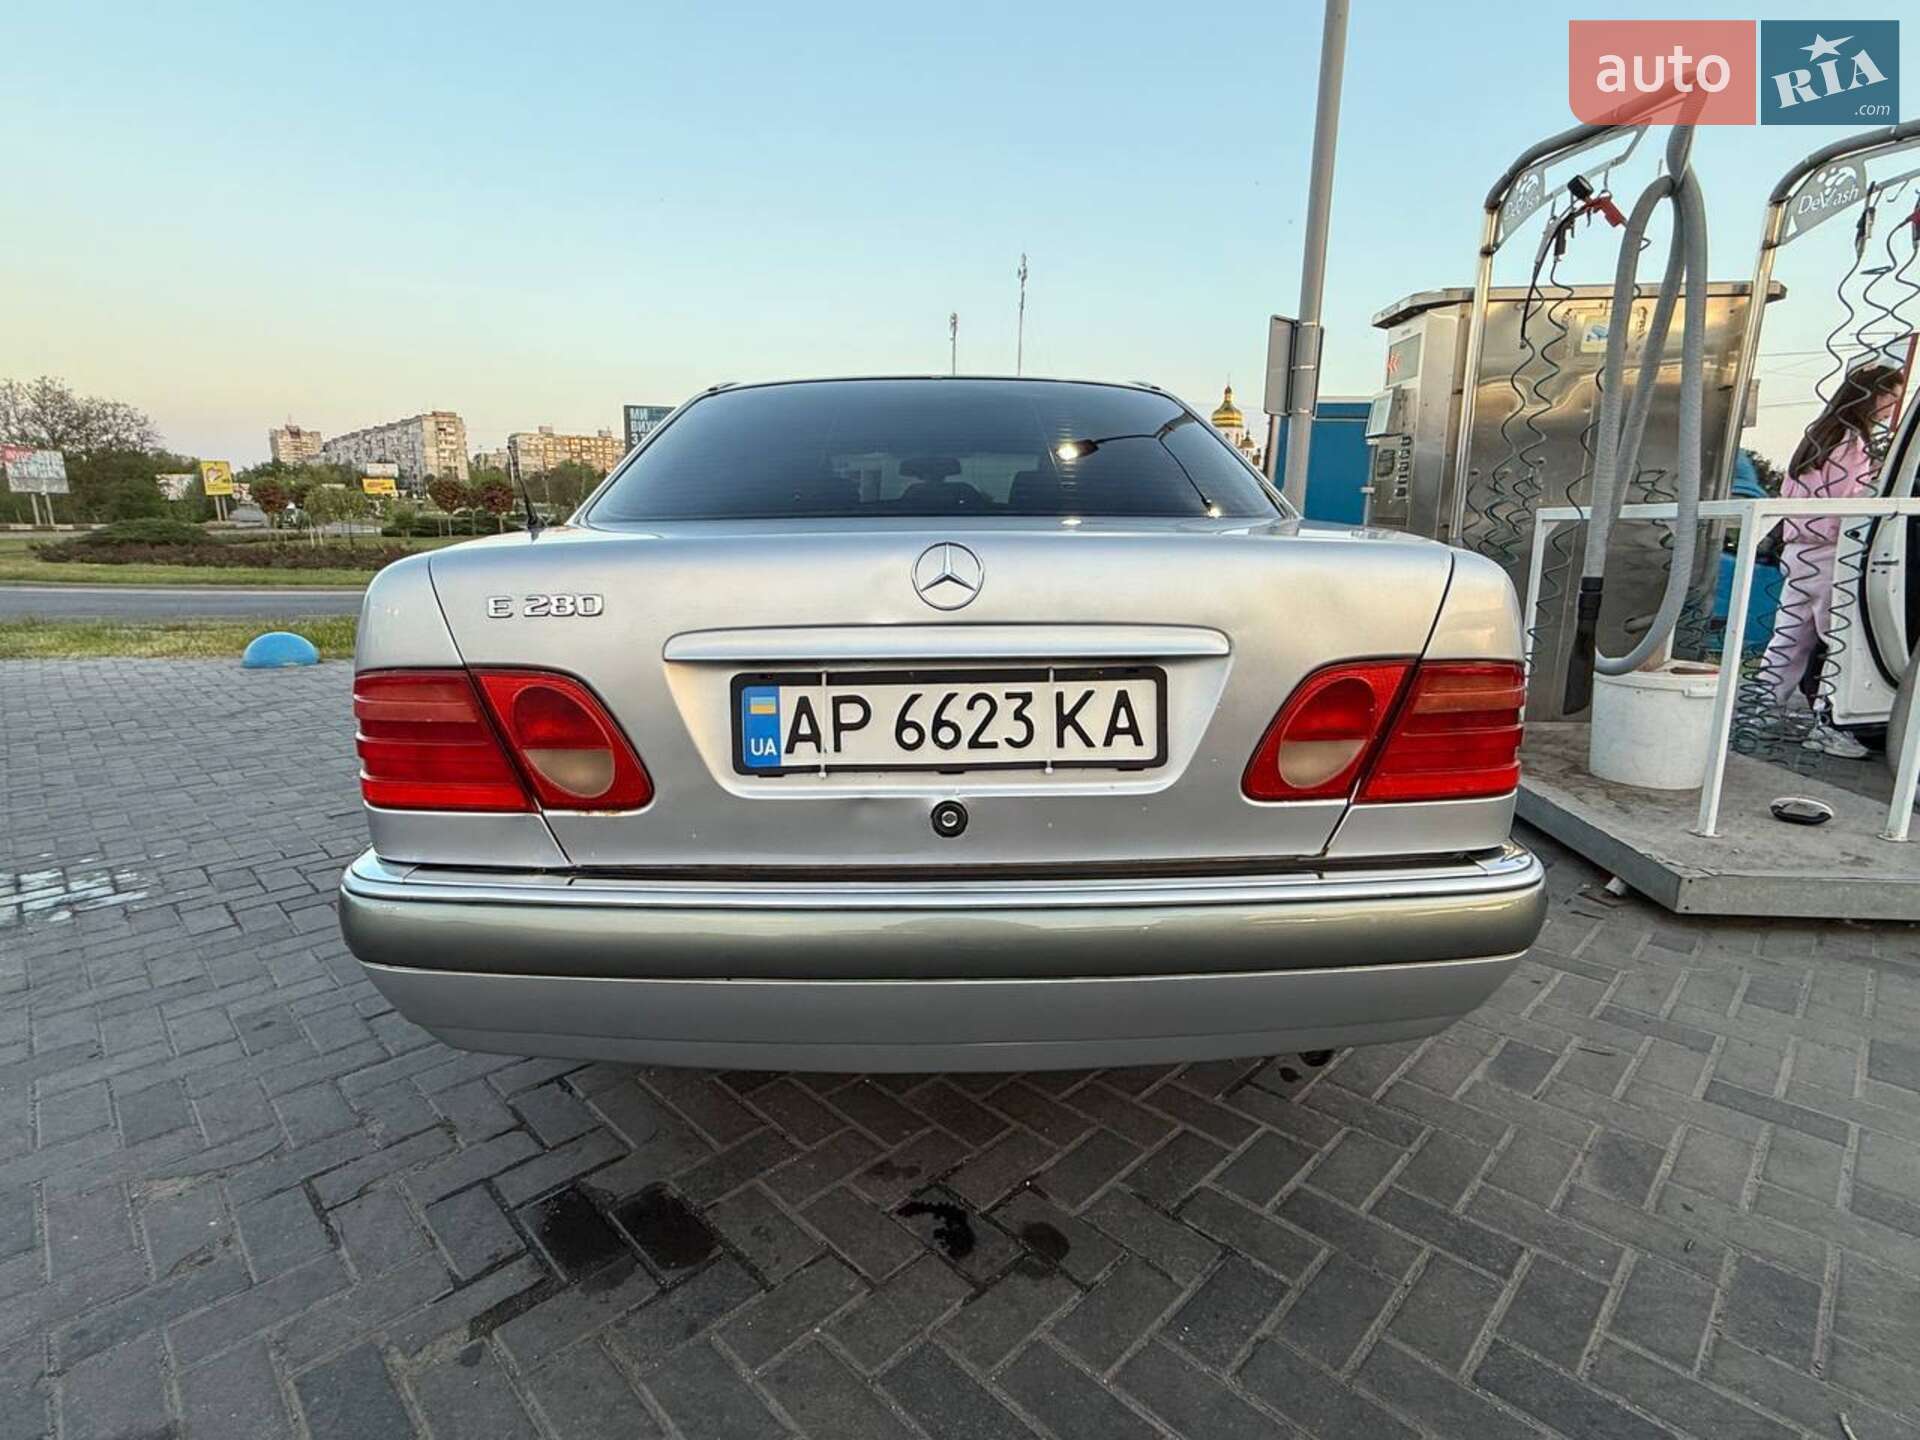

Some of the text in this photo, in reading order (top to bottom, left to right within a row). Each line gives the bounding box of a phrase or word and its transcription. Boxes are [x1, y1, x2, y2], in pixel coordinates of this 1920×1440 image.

[487, 594, 603, 618] E 280
[785, 690, 1144, 754] AP 6623 KA
[751, 738, 778, 756] UA
